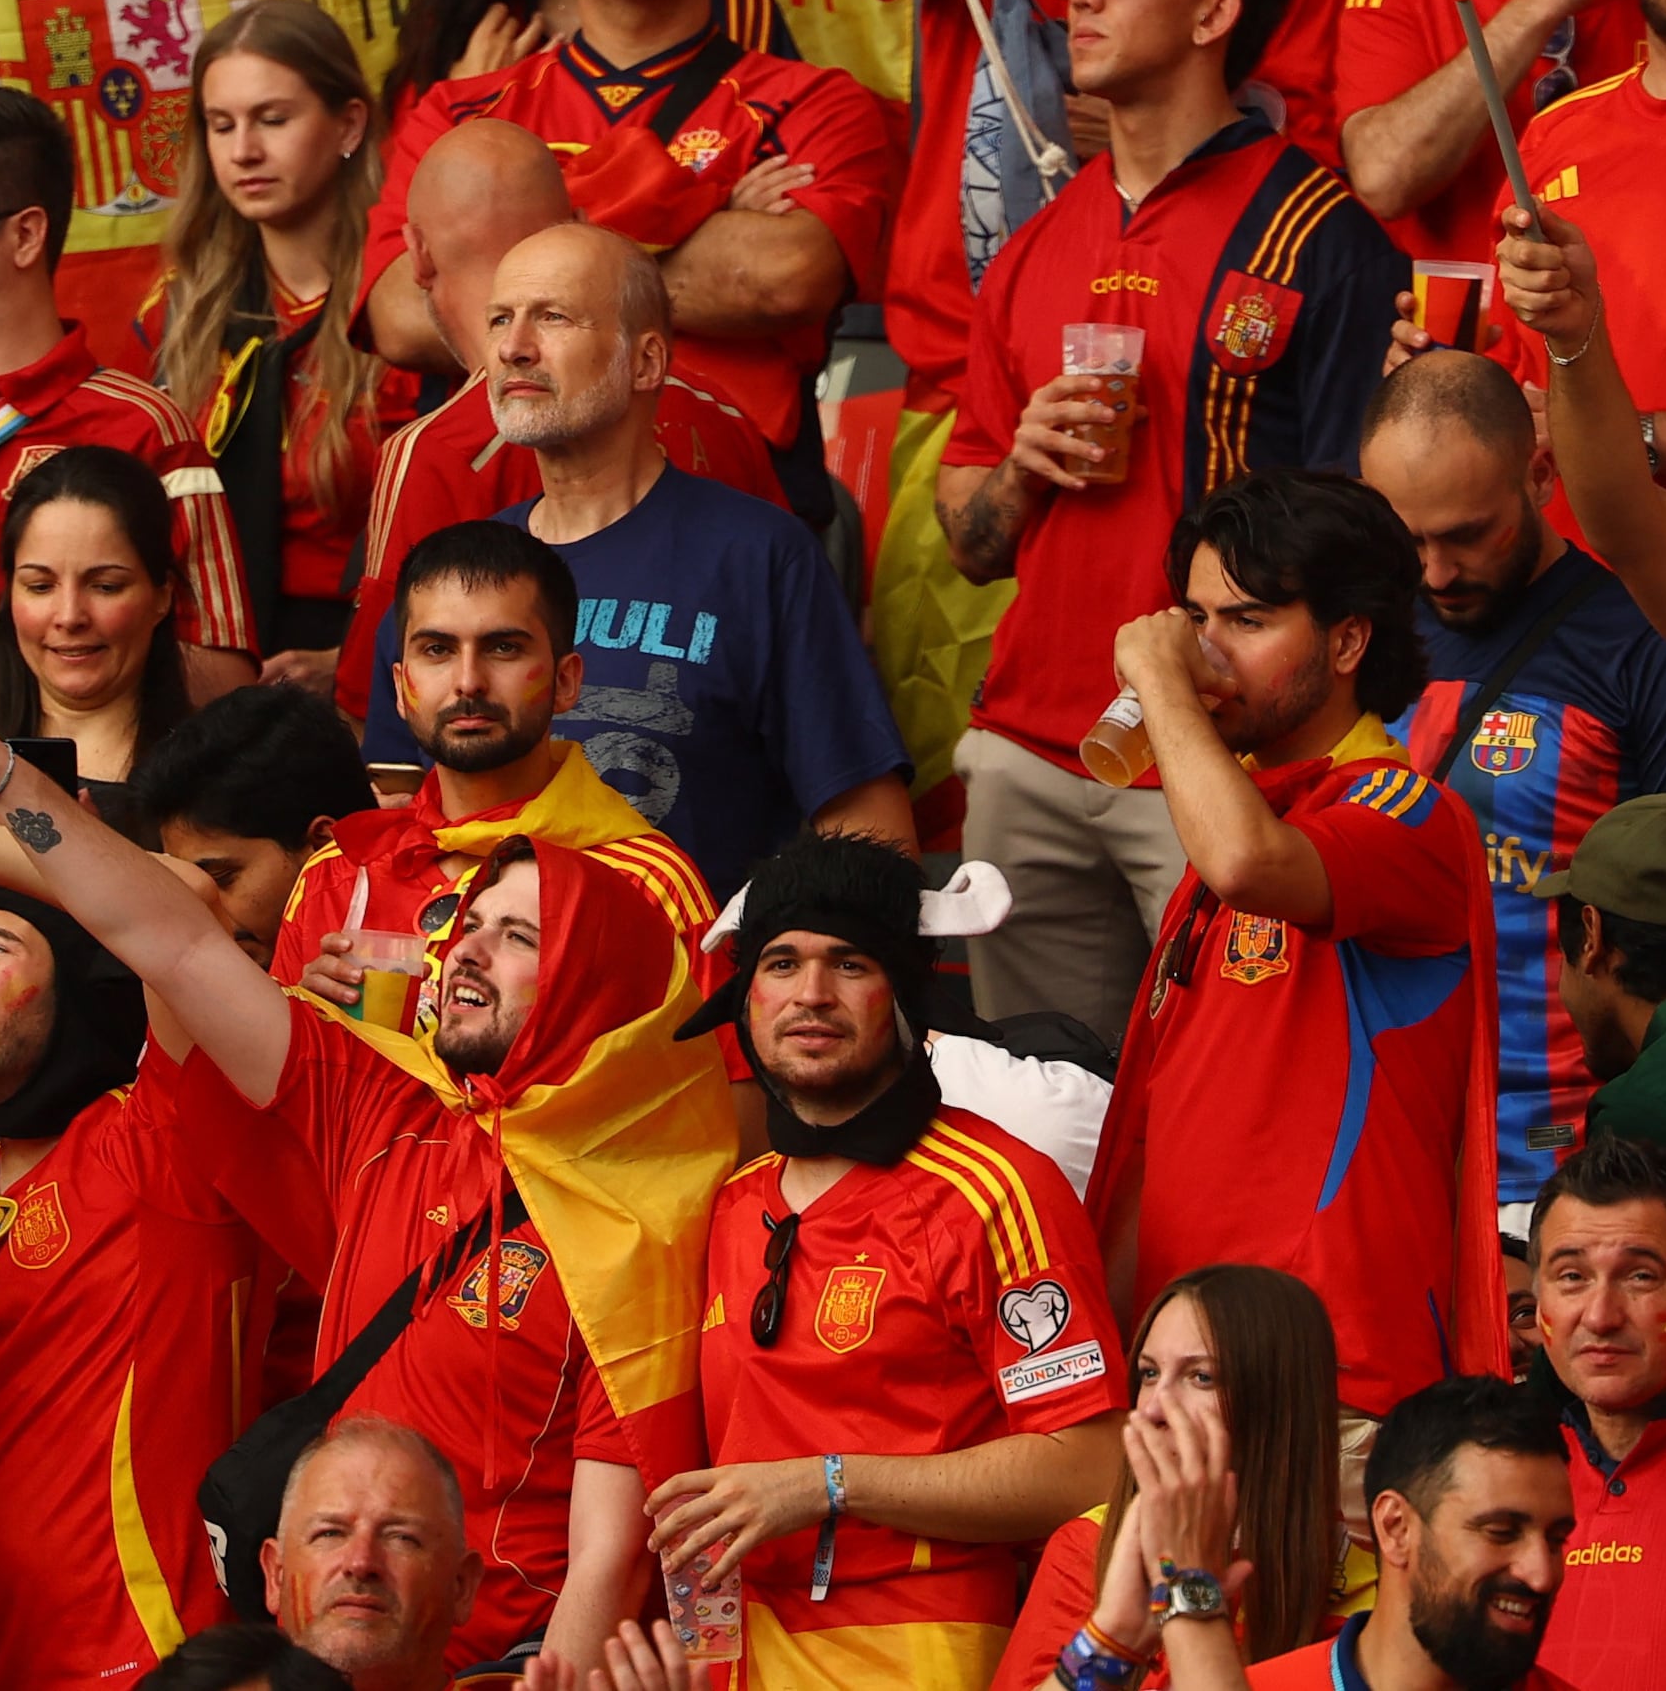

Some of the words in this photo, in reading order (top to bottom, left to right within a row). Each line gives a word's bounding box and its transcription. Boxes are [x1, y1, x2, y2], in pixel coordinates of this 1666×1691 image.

[1090, 269, 1160, 296] adidas
[1488, 736, 1517, 748] FCB
[1001, 1366, 1024, 1379] UEFA
[1004, 1352, 1101, 1391] FOUNDATION
[1565, 1540, 1643, 1568] adidas
